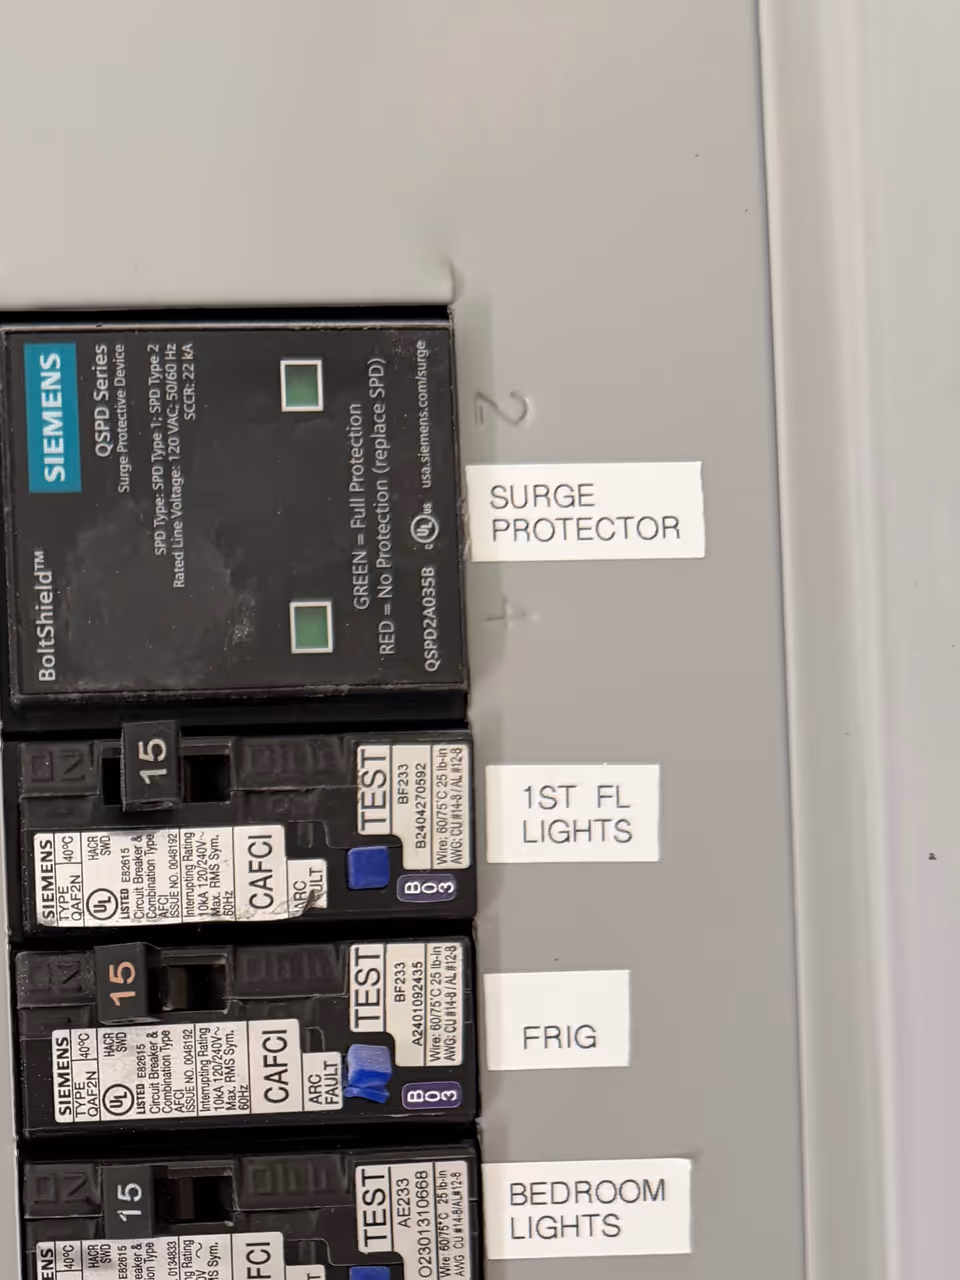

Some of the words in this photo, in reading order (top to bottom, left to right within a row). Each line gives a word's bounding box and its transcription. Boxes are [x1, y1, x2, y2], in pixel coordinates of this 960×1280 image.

[113, 345, 126, 387] Device
[147, 344, 159, 353] 2
[165, 345, 176, 360] Hz
[181, 344, 193, 360] kA
[93, 345, 109, 402] Series
[148, 356, 164, 385] Type
[166, 363, 178, 401] 50/60
[182, 364, 194, 379] 22
[368, 357, 387, 398] SPD)
[40, 353, 66, 482] SIEMENS
[149, 389, 161, 413] SPD
[183, 383, 195, 420] SCCR:
[416, 340, 432, 488] usa.siemens.com/surge
[95, 407, 113, 458] QSPD
[115, 390, 128, 453] Protective
[371, 404, 389, 474] (replace
[151, 433, 166, 462] Type
[168, 437, 180, 462] 120
[347, 404, 365, 492] Protection
[118, 456, 132, 493] Surge
[152, 465, 164, 490] SPD
[169, 467, 184, 518] Voltage:
[153, 494, 168, 528] Type:
[350, 499, 366, 528] Full
[490, 483, 596, 509] SURGE
[171, 521, 183, 548] Line
[374, 480, 392, 568] Protection
[492, 516, 680, 542] PROTECTOR
[154, 531, 167, 555] SPD
[172, 551, 185, 588] Rated
[354, 551, 370, 609] GREEN
[377, 574, 393, 599] No
[379, 621, 395, 654] RED
[421, 567, 439, 672] QSPD2A035B
[138, 738, 167, 784] 15
[360, 749, 386, 831] TEST
[398, 764, 409, 804] BF233
[523, 785, 577, 810] 1ST
[597, 785, 631, 808] FL
[523, 818, 632, 843] LIGHTS
[40, 840, 55, 919] SIEMENS
[248, 834, 274, 910] CAFCI
[109, 962, 136, 1006] 15
[354, 947, 380, 1028] TEST
[394, 962, 405, 1003] BF233
[523, 1024, 597, 1049] FRIG
[56, 1037, 71, 1116] SIEMENS
[262, 1029, 288, 1104] CAFCI
[117, 1183, 142, 1221] 15
[361, 1169, 387, 1247] TEST
[396, 1178, 411, 1228] AE233
[509, 1178, 665, 1206] BEDROOM
[510, 1213, 621, 1239] LIGHTS
[88, 1244, 99, 1268] HACR
[100, 1244, 111, 1263] SWD
[118, 1245, 128, 1279] E82615
[181, 1240, 194, 1268] Rating
